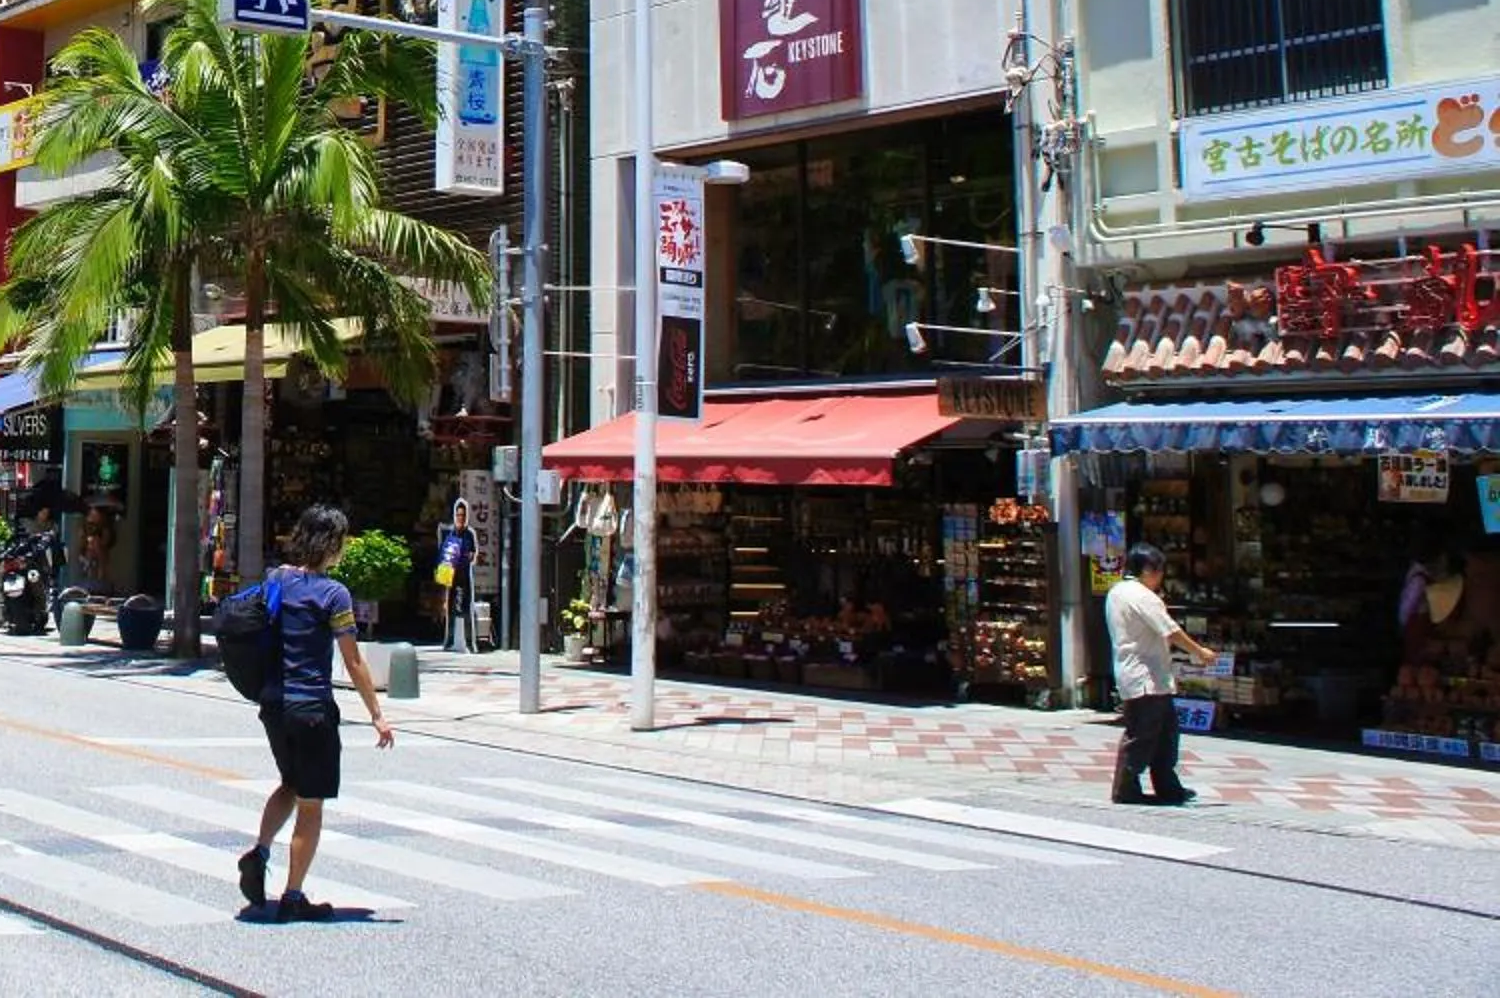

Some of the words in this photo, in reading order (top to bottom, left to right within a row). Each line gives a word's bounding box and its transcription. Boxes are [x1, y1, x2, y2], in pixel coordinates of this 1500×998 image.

[787, 31, 844, 63] KEYSTONE
[1432, 93, 1500, 157] ど
[1203, 113, 1429, 174] 宮古そばの名所
[687, 351, 695, 382] zero
[3, 414, 47, 437] SILVERS
